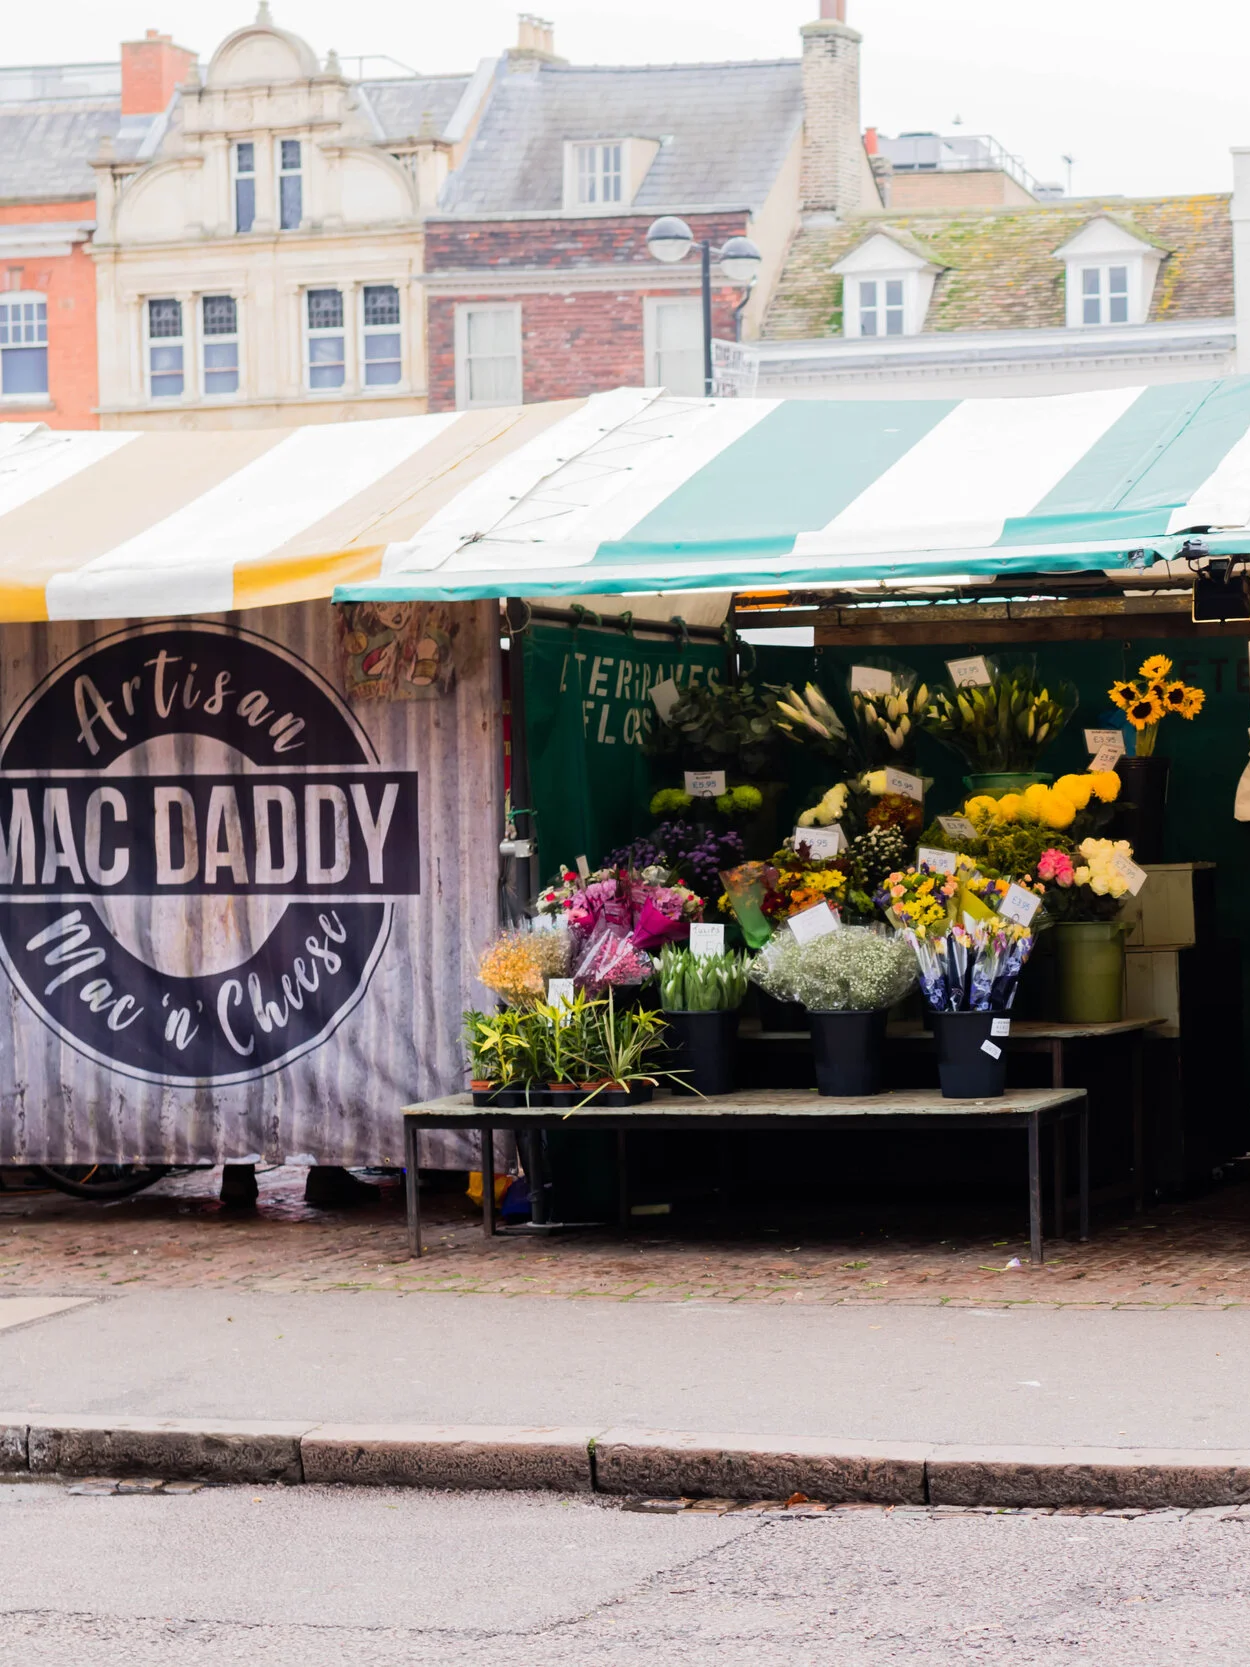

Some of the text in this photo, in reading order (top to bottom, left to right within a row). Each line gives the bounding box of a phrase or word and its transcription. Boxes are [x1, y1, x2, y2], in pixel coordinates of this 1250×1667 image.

[73, 649, 305, 756] Artisan
[0, 782, 400, 887] MAC DADDY
[26, 909, 145, 1031] Mac
[216, 909, 348, 1056] Cheese
